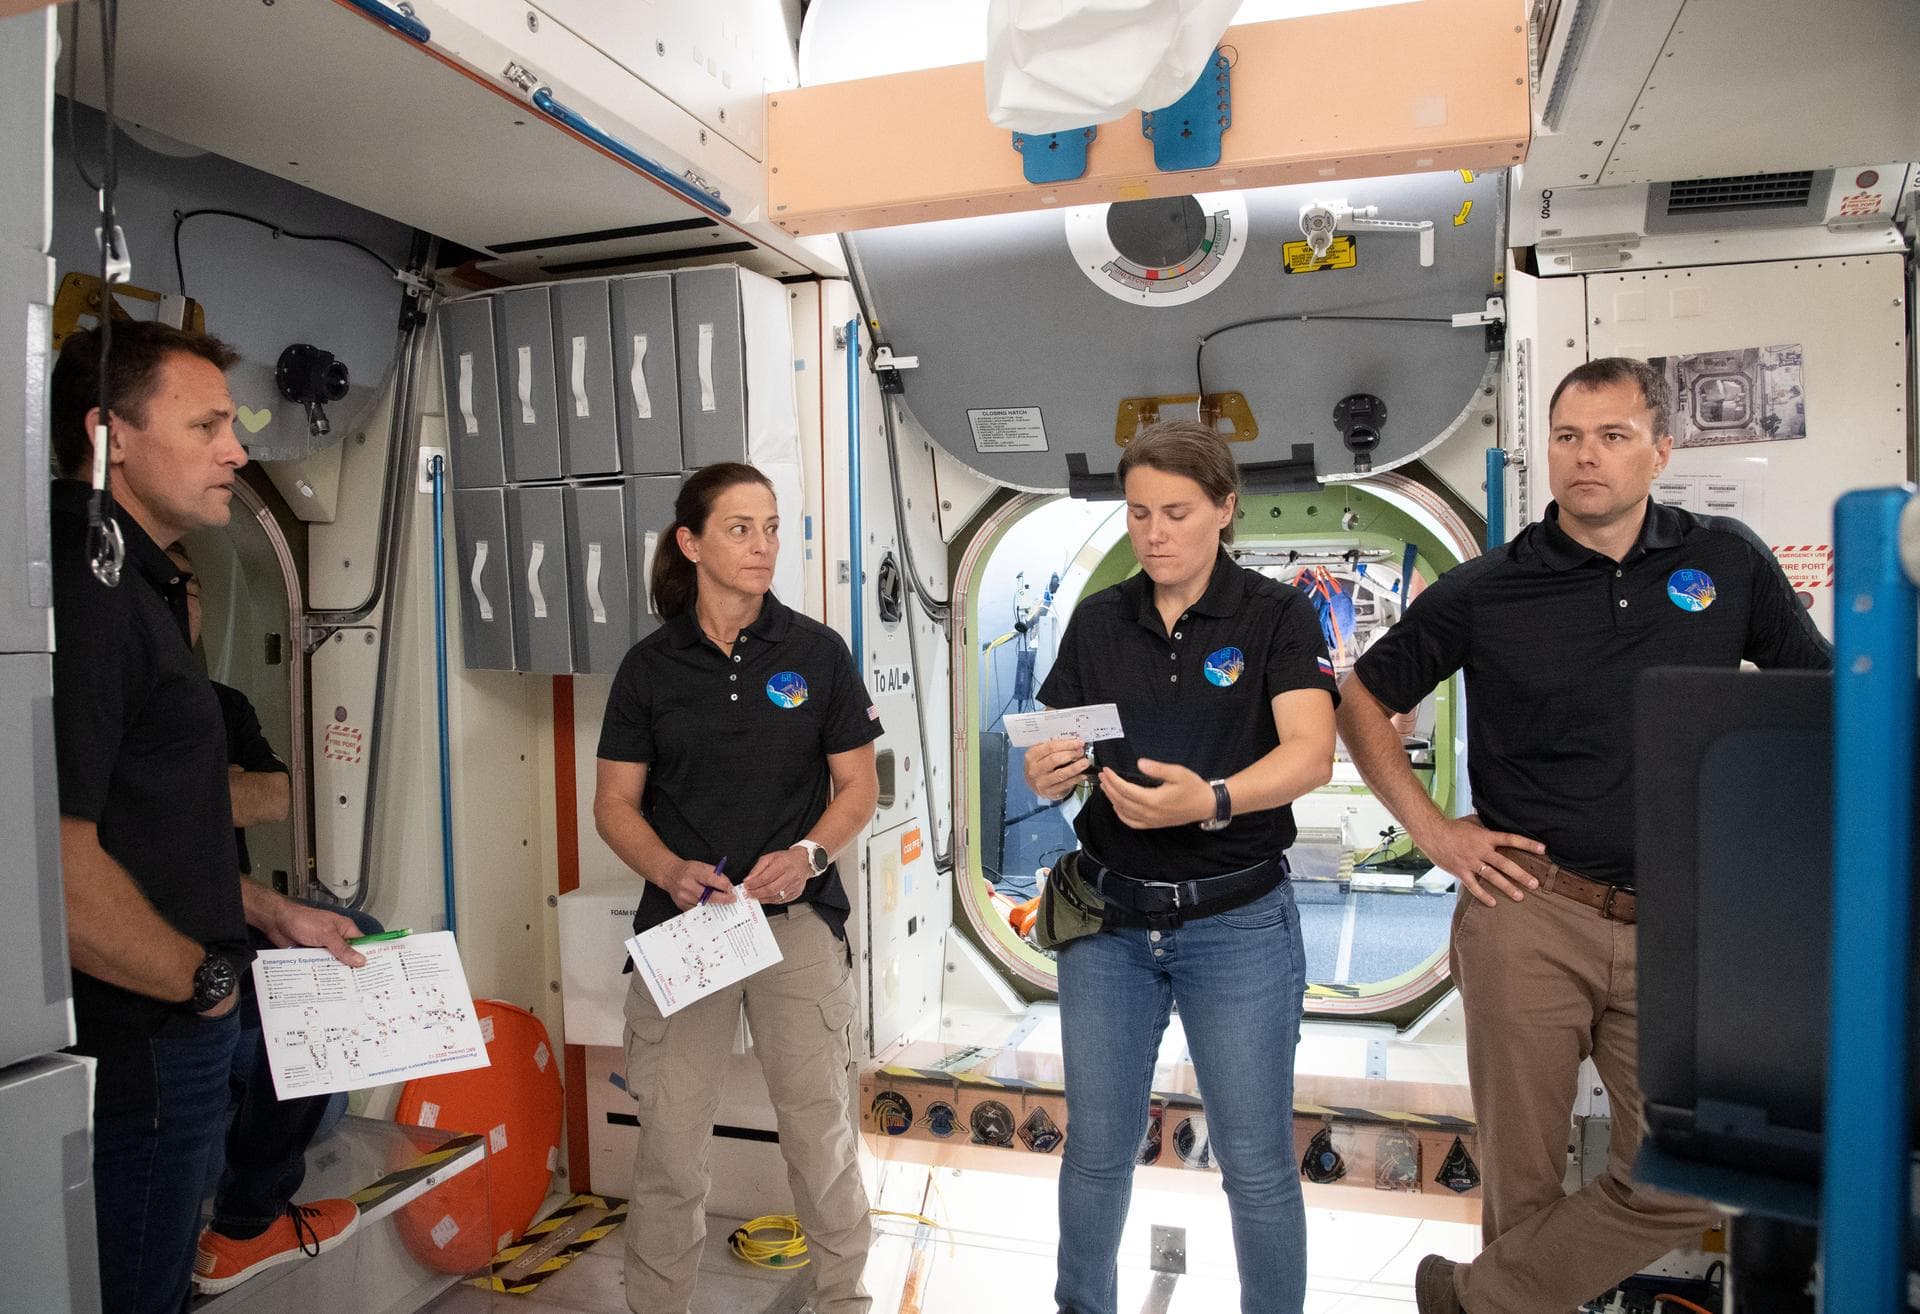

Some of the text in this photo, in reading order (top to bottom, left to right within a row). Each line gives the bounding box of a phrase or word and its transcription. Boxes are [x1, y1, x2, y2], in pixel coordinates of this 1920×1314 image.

[1214, 223, 1223, 252] LATCHED
[1114, 267, 1154, 286] UNLATCHED
[1780, 563, 1799, 571] FIRE
[1681, 571, 1693, 581] 68
[781, 673, 792, 681] 68
[874, 667, 902, 692] To A/L
[262, 958, 297, 966] Emergency
[298, 956, 329, 964] Equipment
